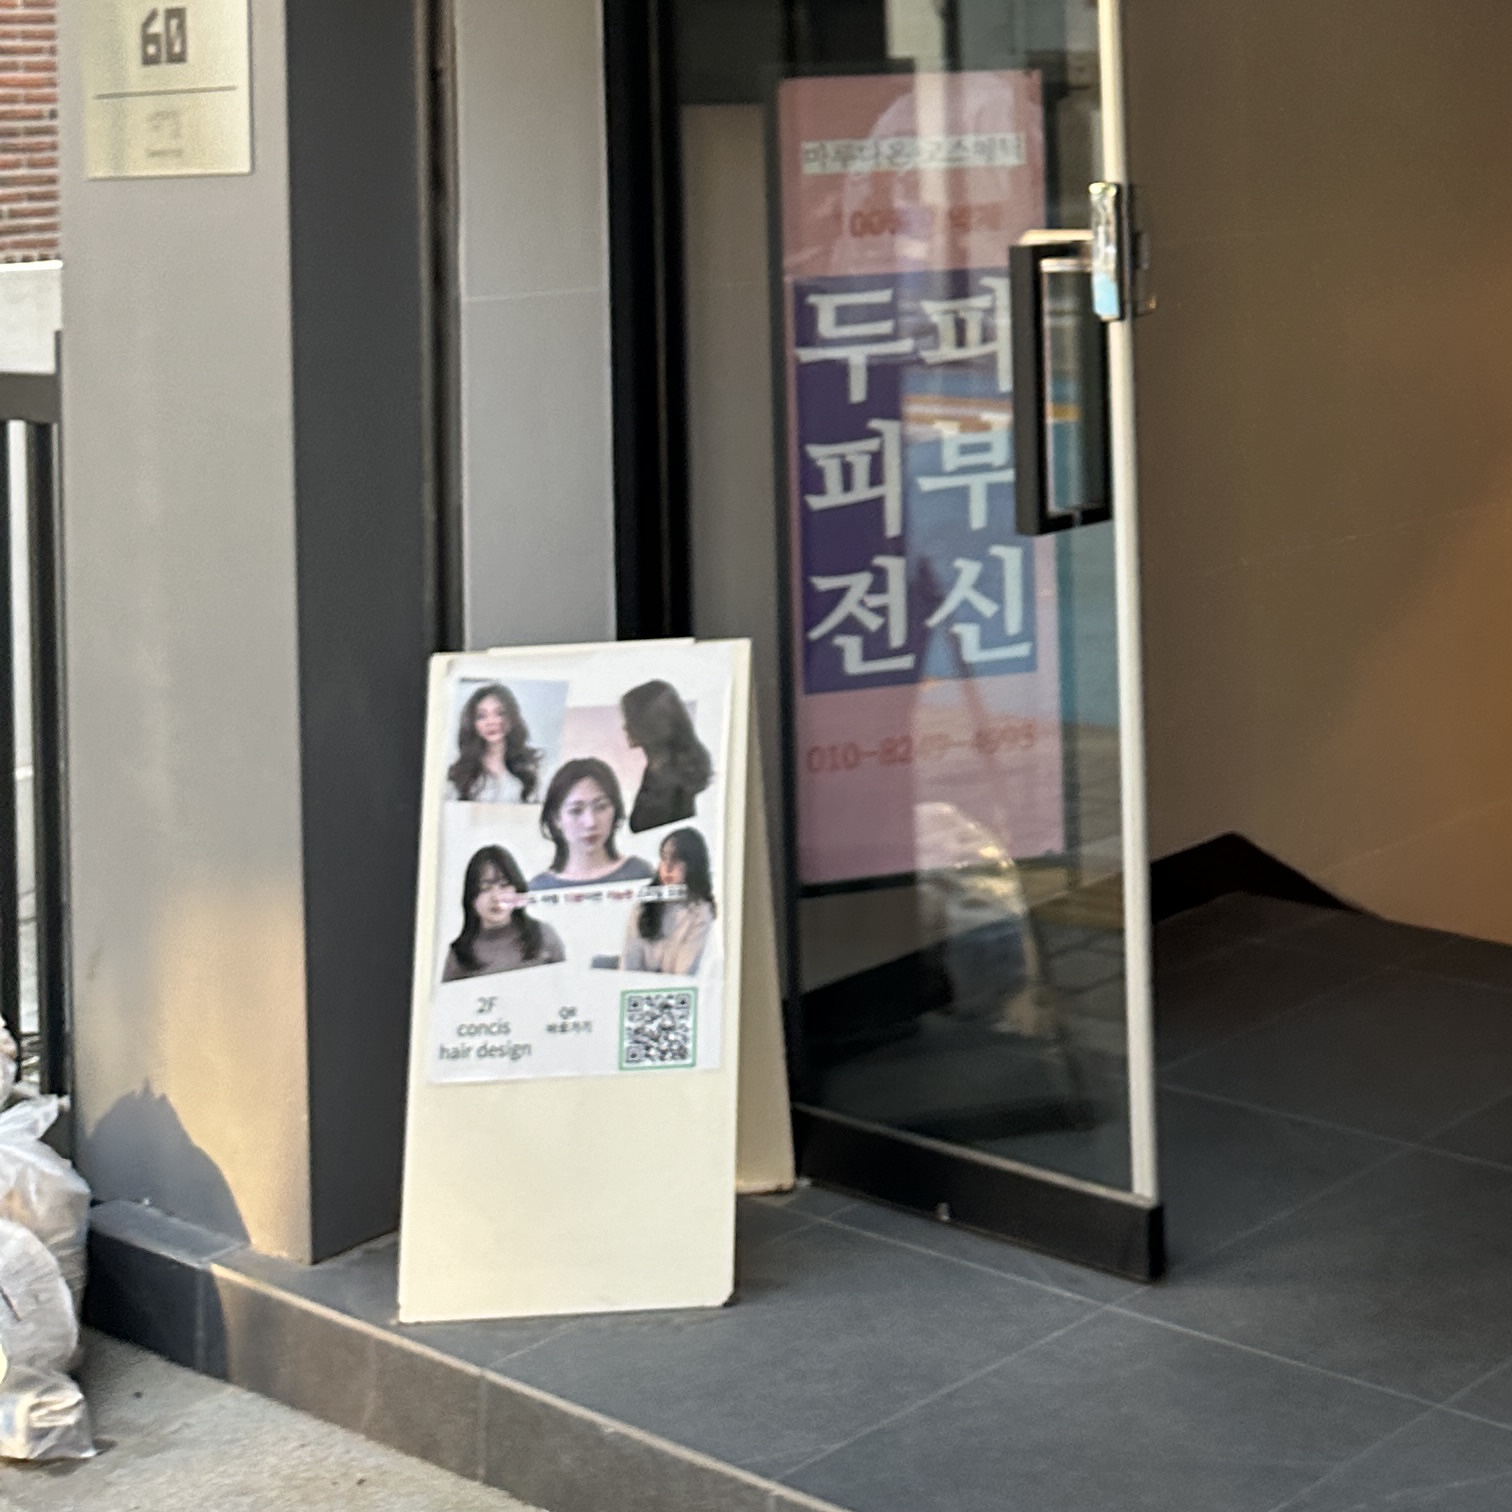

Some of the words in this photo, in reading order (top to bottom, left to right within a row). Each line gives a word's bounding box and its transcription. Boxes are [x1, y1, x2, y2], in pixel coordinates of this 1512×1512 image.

[141, 6, 187, 65] 60
[796, 276, 1013, 404] 두피
[805, 413, 1015, 539] 피부
[808, 545, 1033, 676] 전신
[456, 1017, 512, 1037] concis
[476, 996, 498, 1014] 2F
[438, 1042, 473, 1061] hair
[476, 1039, 532, 1063] design
